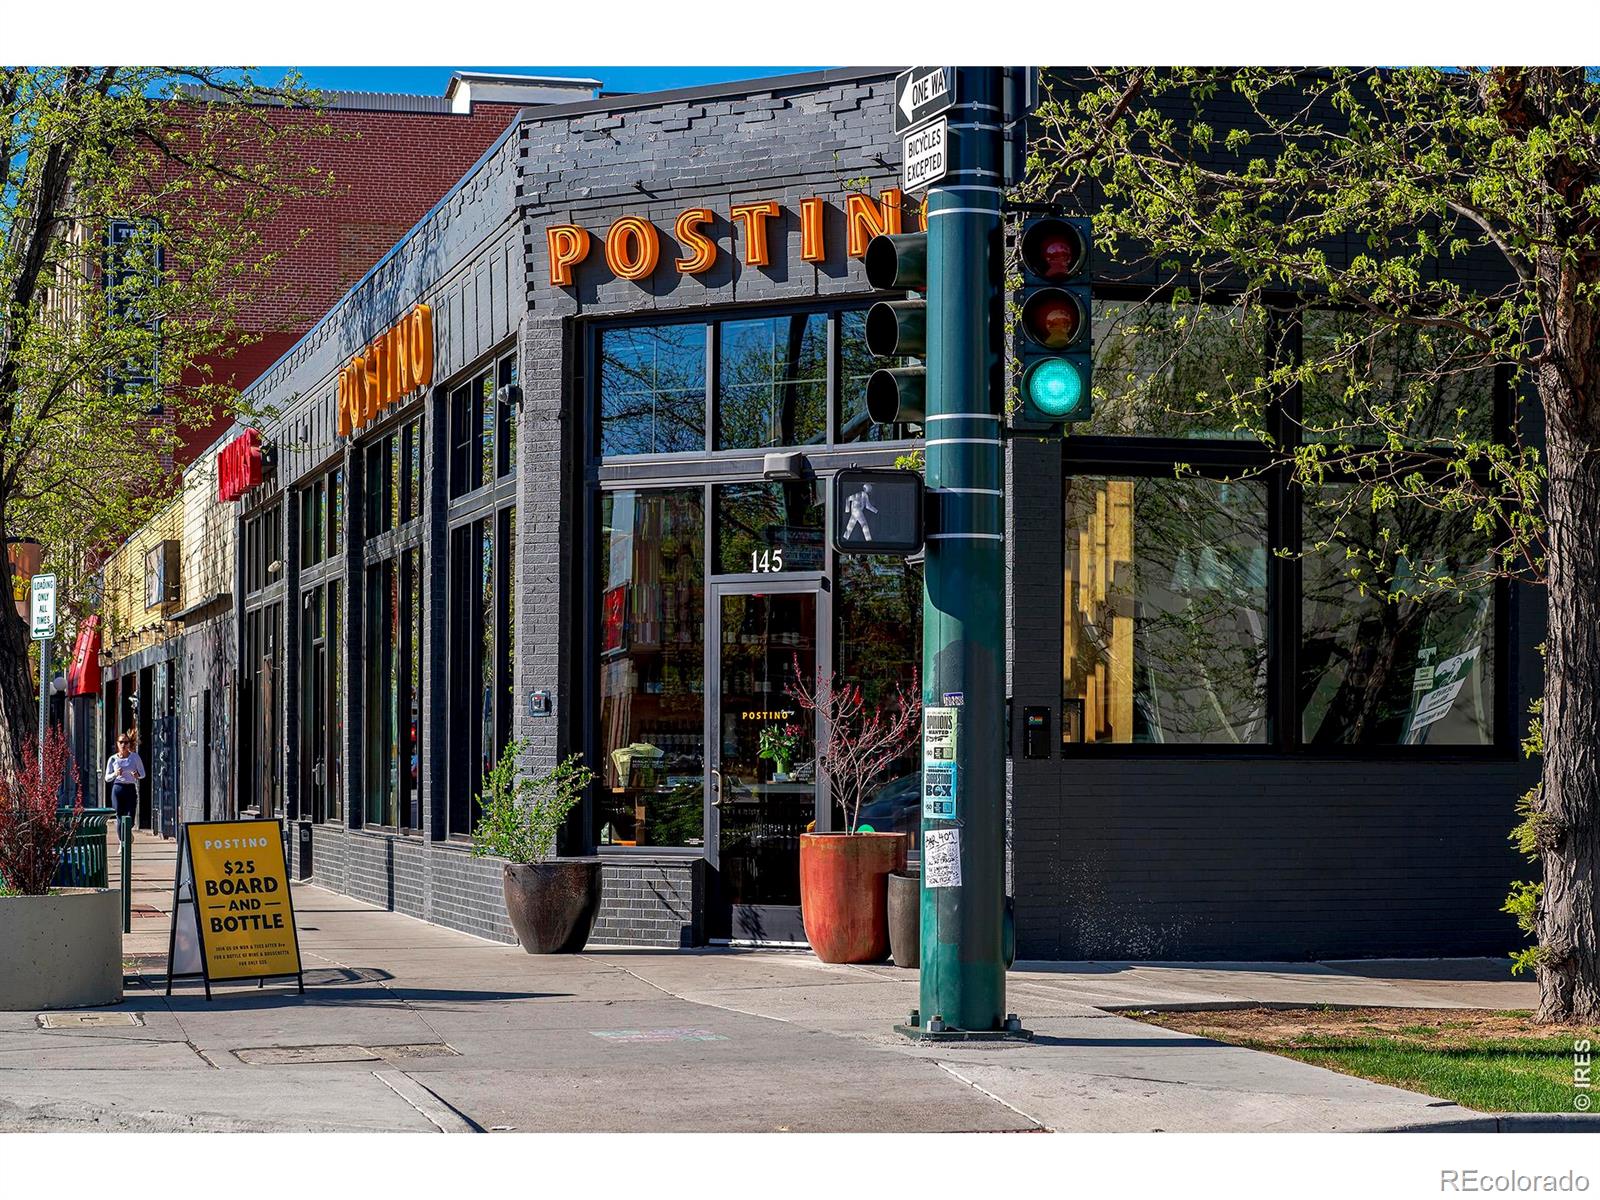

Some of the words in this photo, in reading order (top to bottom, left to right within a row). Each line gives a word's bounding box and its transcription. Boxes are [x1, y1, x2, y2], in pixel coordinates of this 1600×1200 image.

[912, 78, 929, 106] ONE
[931, 66, 949, 97] WAY
[908, 128, 941, 158] BICYCLES
[907, 152, 942, 182] EXCEPTED
[546, 188, 928, 286] POSTIN
[338, 303, 433, 437] POSTINO
[751, 549, 783, 573] 145
[34, 580, 53, 591] LOADING
[38, 593, 49, 602] ONLY
[39, 605, 47, 613] ALL
[37, 615, 50, 625] TIMES
[742, 711, 788, 720] POSTINO
[925, 785, 953, 797] BOX
[204, 837, 268, 850] POSTINO
[223, 860, 256, 877] $25
[205, 876, 279, 897] BOARD
[228, 898, 261, 912] AND
[210, 913, 285, 933] BOTTLE
